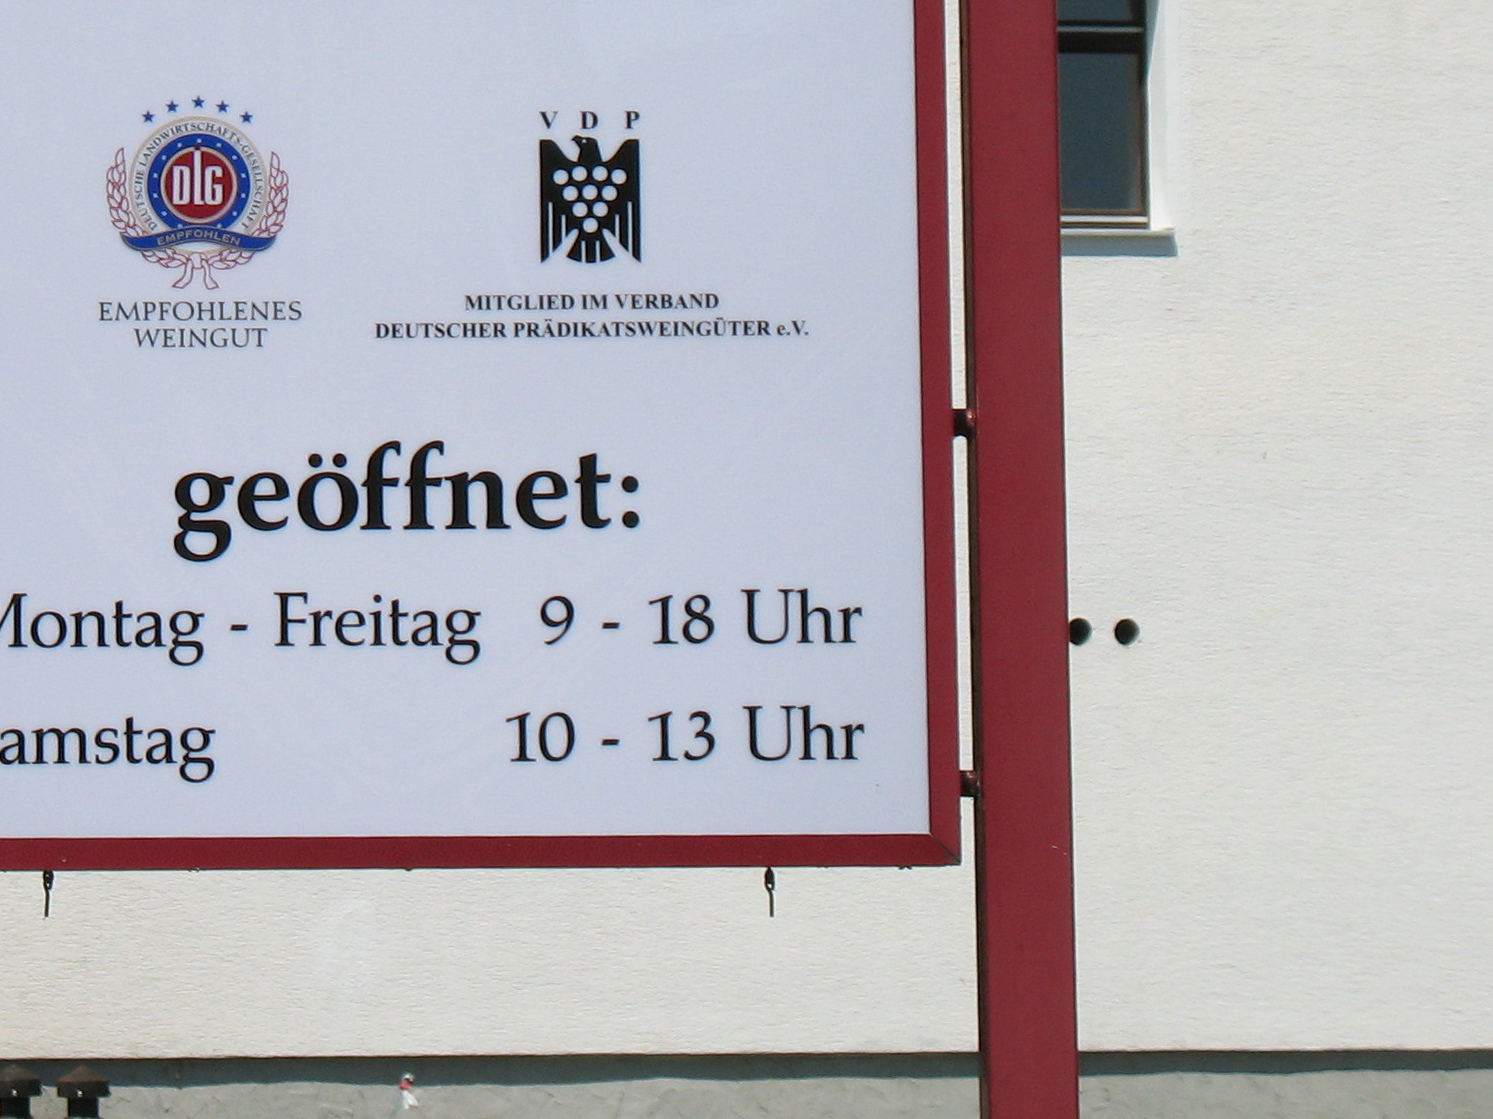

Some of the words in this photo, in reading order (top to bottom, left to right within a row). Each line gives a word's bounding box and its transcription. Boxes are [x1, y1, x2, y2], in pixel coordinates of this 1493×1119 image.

[172, 148, 223, 206] DLG
[156, 229, 241, 246] EMPFOHLEN
[99, 300, 303, 322] EMPFOHLENES
[465, 294, 575, 311] MITGLIED
[581, 294, 608, 310] IM
[614, 293, 720, 310] VERBAND
[133, 327, 268, 349] WEINGUT
[375, 322, 507, 339] DEUTSCHER
[513, 317, 771, 338] PRÄDIKATSWEINGÜTER
[776, 320, 810, 337] e.V.
[173, 440, 641, 563] geöffnet:
[273, 591, 482, 666] Freitag
[539, 595, 575, 646] 9
[648, 594, 715, 645] 18
[740, 587, 863, 645] Uhr
[505, 711, 576, 763] 10
[647, 710, 716, 762] 13
[742, 704, 865, 762] Uhr
